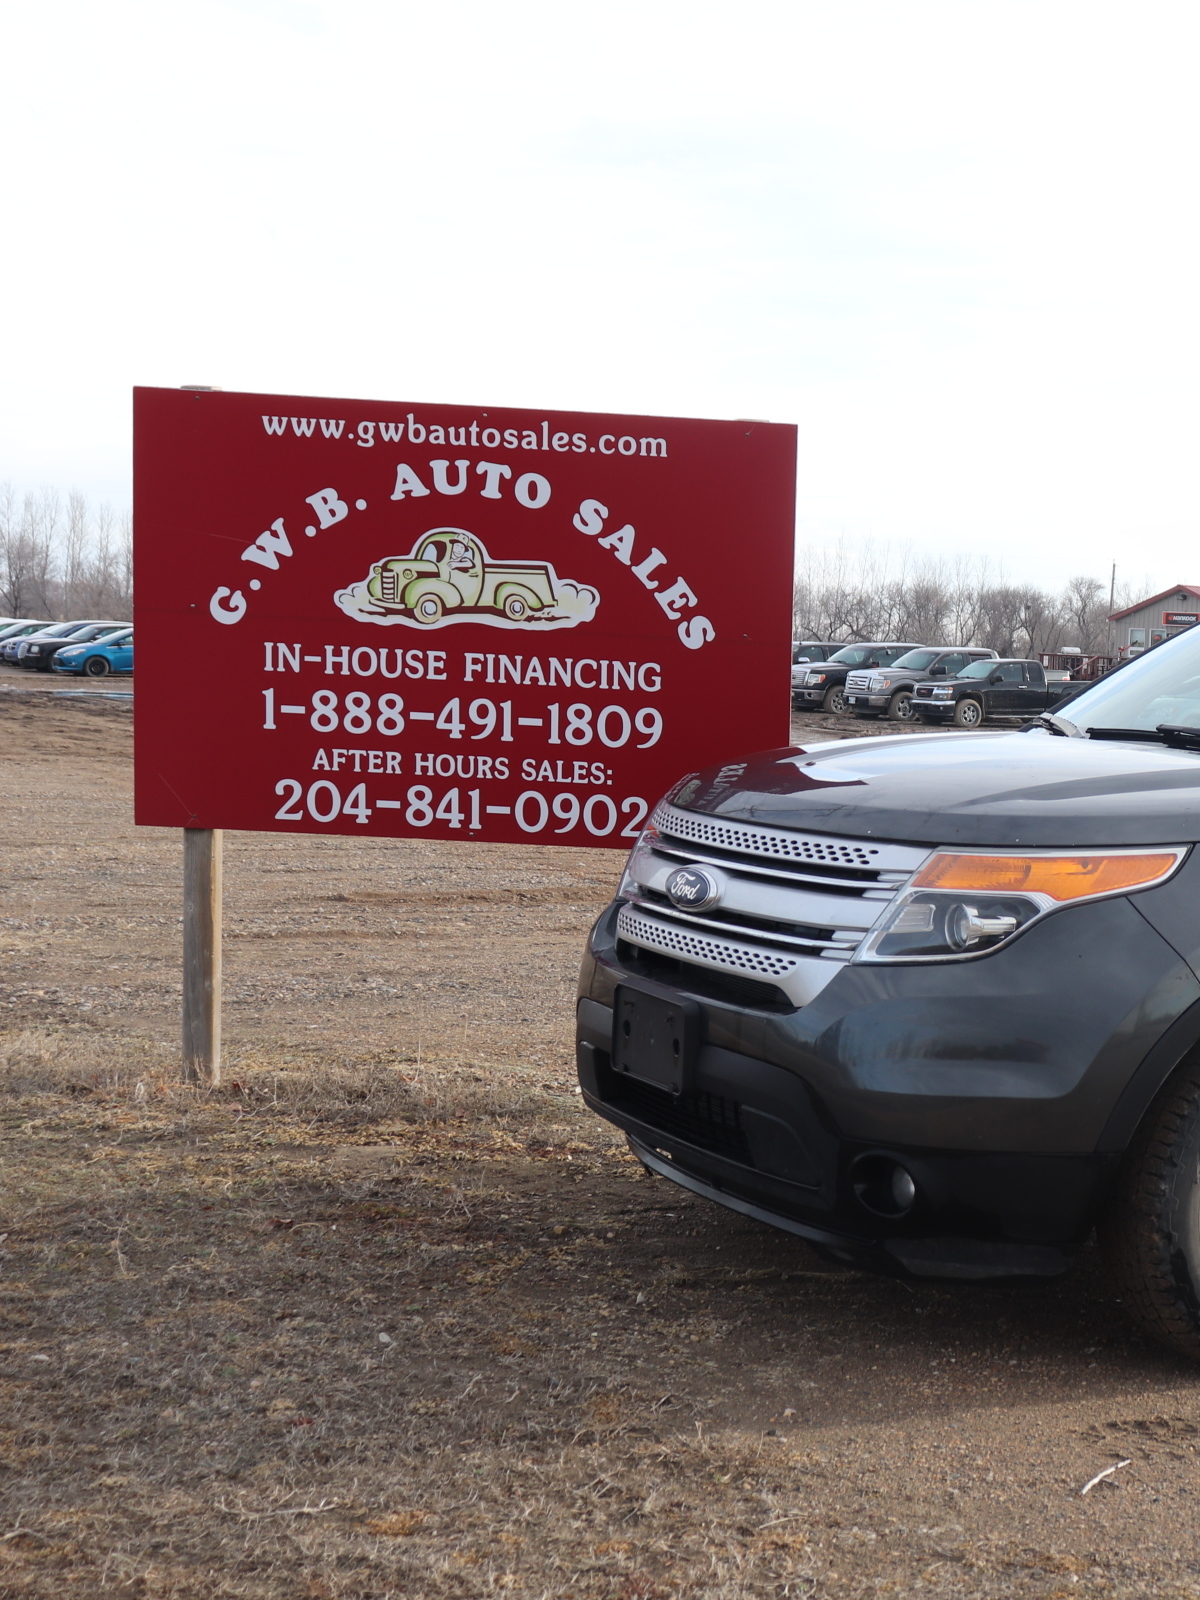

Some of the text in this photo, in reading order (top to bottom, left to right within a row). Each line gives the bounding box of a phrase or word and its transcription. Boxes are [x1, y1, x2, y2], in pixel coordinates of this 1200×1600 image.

[261, 412, 668, 458] www.gwbautosales.com
[209, 459, 716, 650] G.W.B. AUTO SALES
[263, 641, 662, 693] IN-HOUSE FINANCING
[261, 687, 663, 749] 1-888-491-1809
[312, 748, 614, 786] AFTER HOURS SALES:
[274, 778, 648, 838] 204-841-0902
[671, 872, 700, 900] Ford
